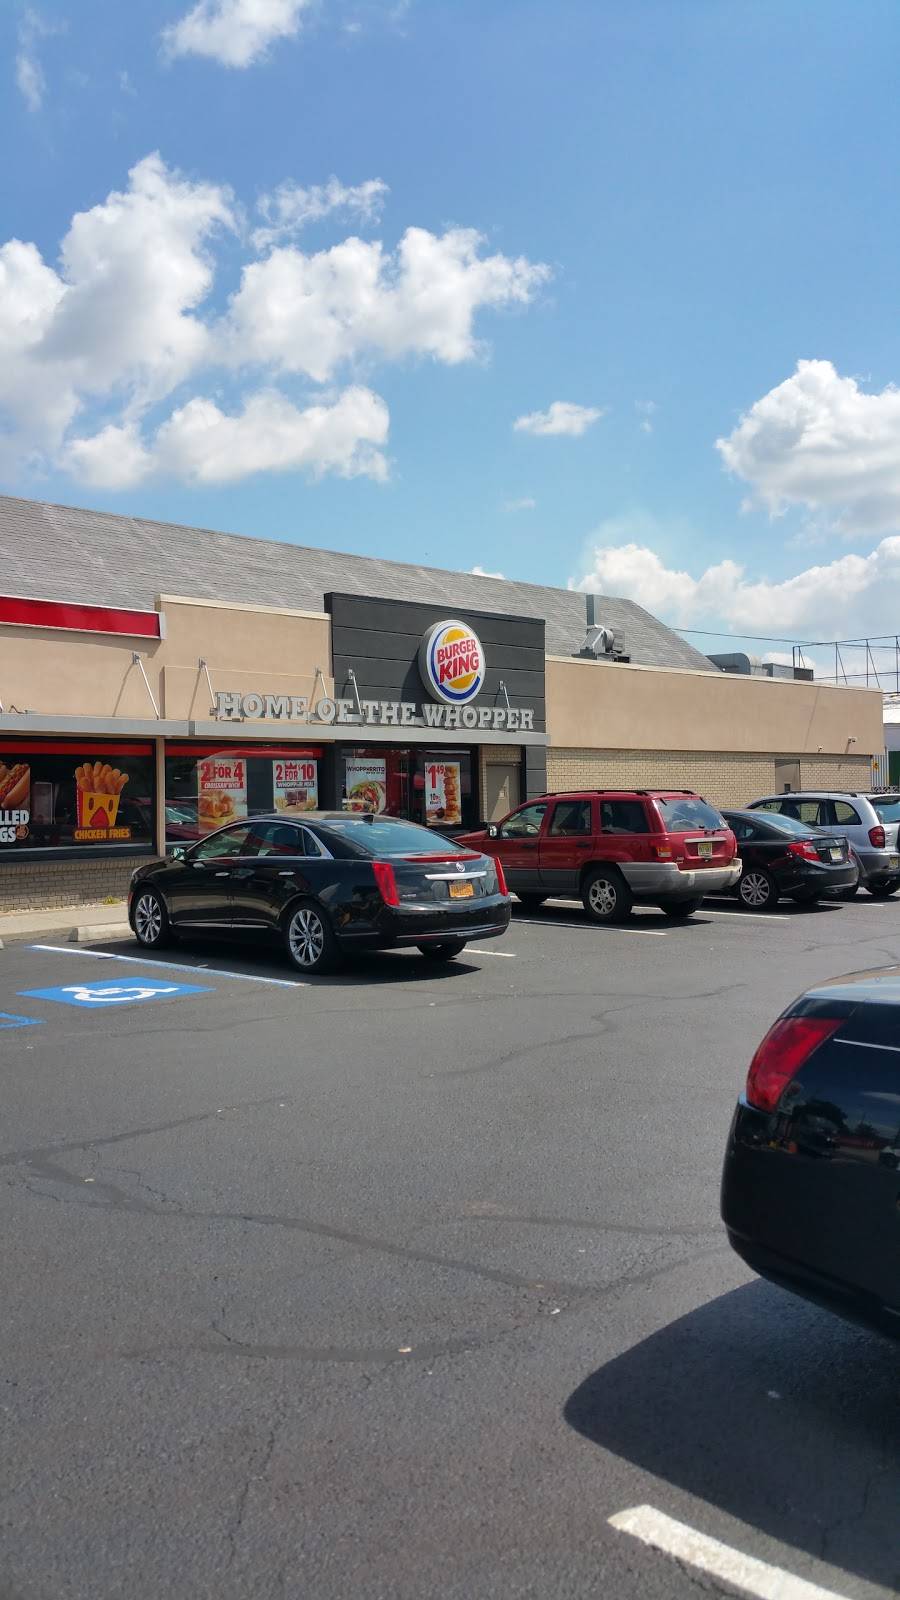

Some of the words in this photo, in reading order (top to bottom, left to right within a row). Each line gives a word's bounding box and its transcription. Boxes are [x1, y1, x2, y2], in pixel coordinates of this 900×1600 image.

[437, 638, 477, 664] BURGER
[439, 651, 479, 683] KING
[215, 691, 309, 720] HOME
[317, 698, 355, 723] OF
[362, 699, 416, 726] THE
[422, 703, 534, 730] WHOPPER
[201, 761, 212, 781] 2
[213, 766, 231, 778] FOR
[276, 764, 283, 780] 2
[285, 770, 298, 780] FOR
[74, 829, 107, 839] CHICKEN
[109, 828, 130, 838] FRIES
